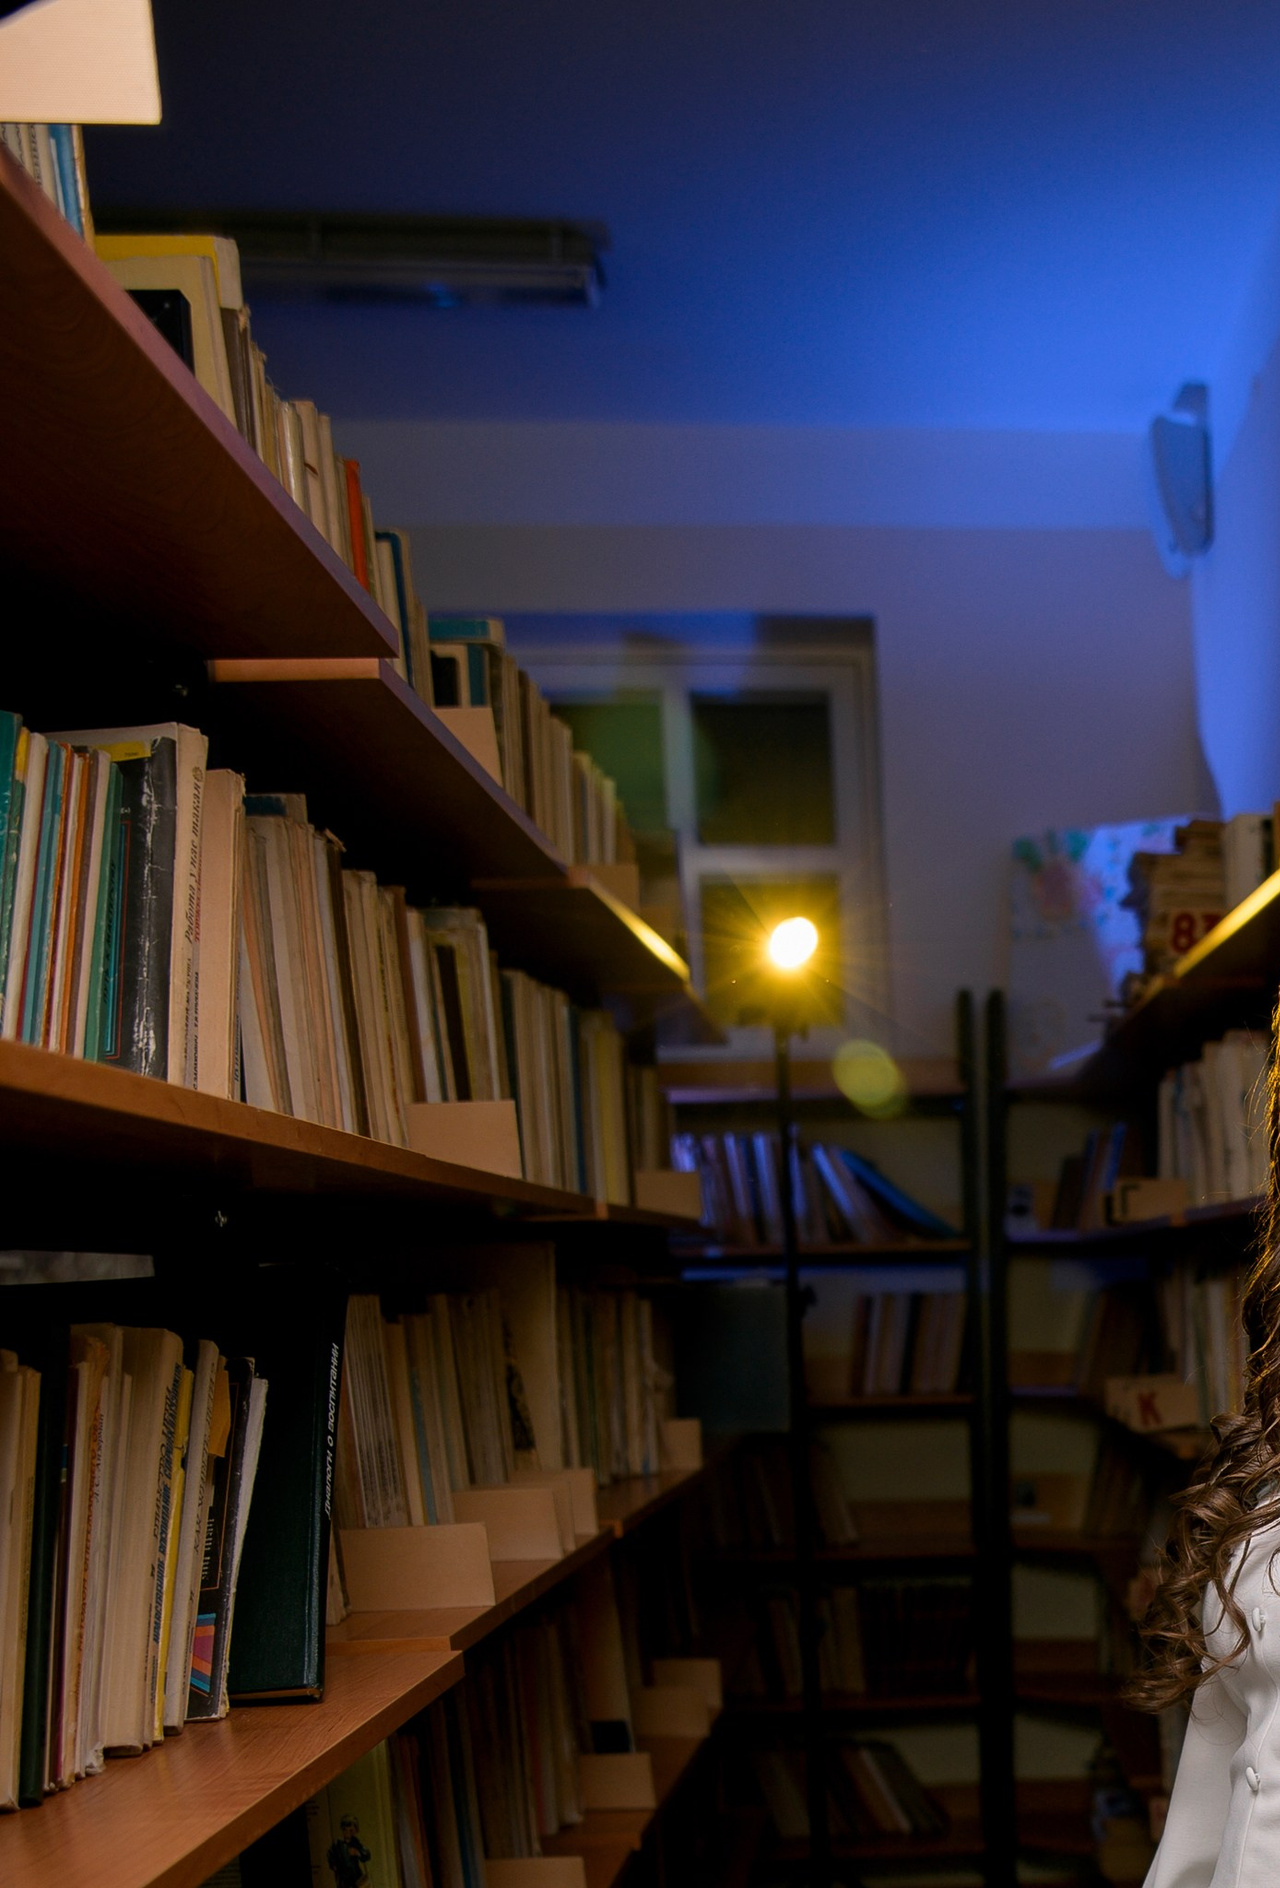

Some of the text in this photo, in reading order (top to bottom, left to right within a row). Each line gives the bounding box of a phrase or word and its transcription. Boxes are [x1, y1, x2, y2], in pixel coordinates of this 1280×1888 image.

[190, 781, 201, 837] такая
[188, 839, 198, 867] нас
[184, 884, 195, 944] Работа
[152, 1443, 166, 1539] ЕДИНСТВО
[157, 1482, 170, 1555] ВОСПИТАНИЕ
